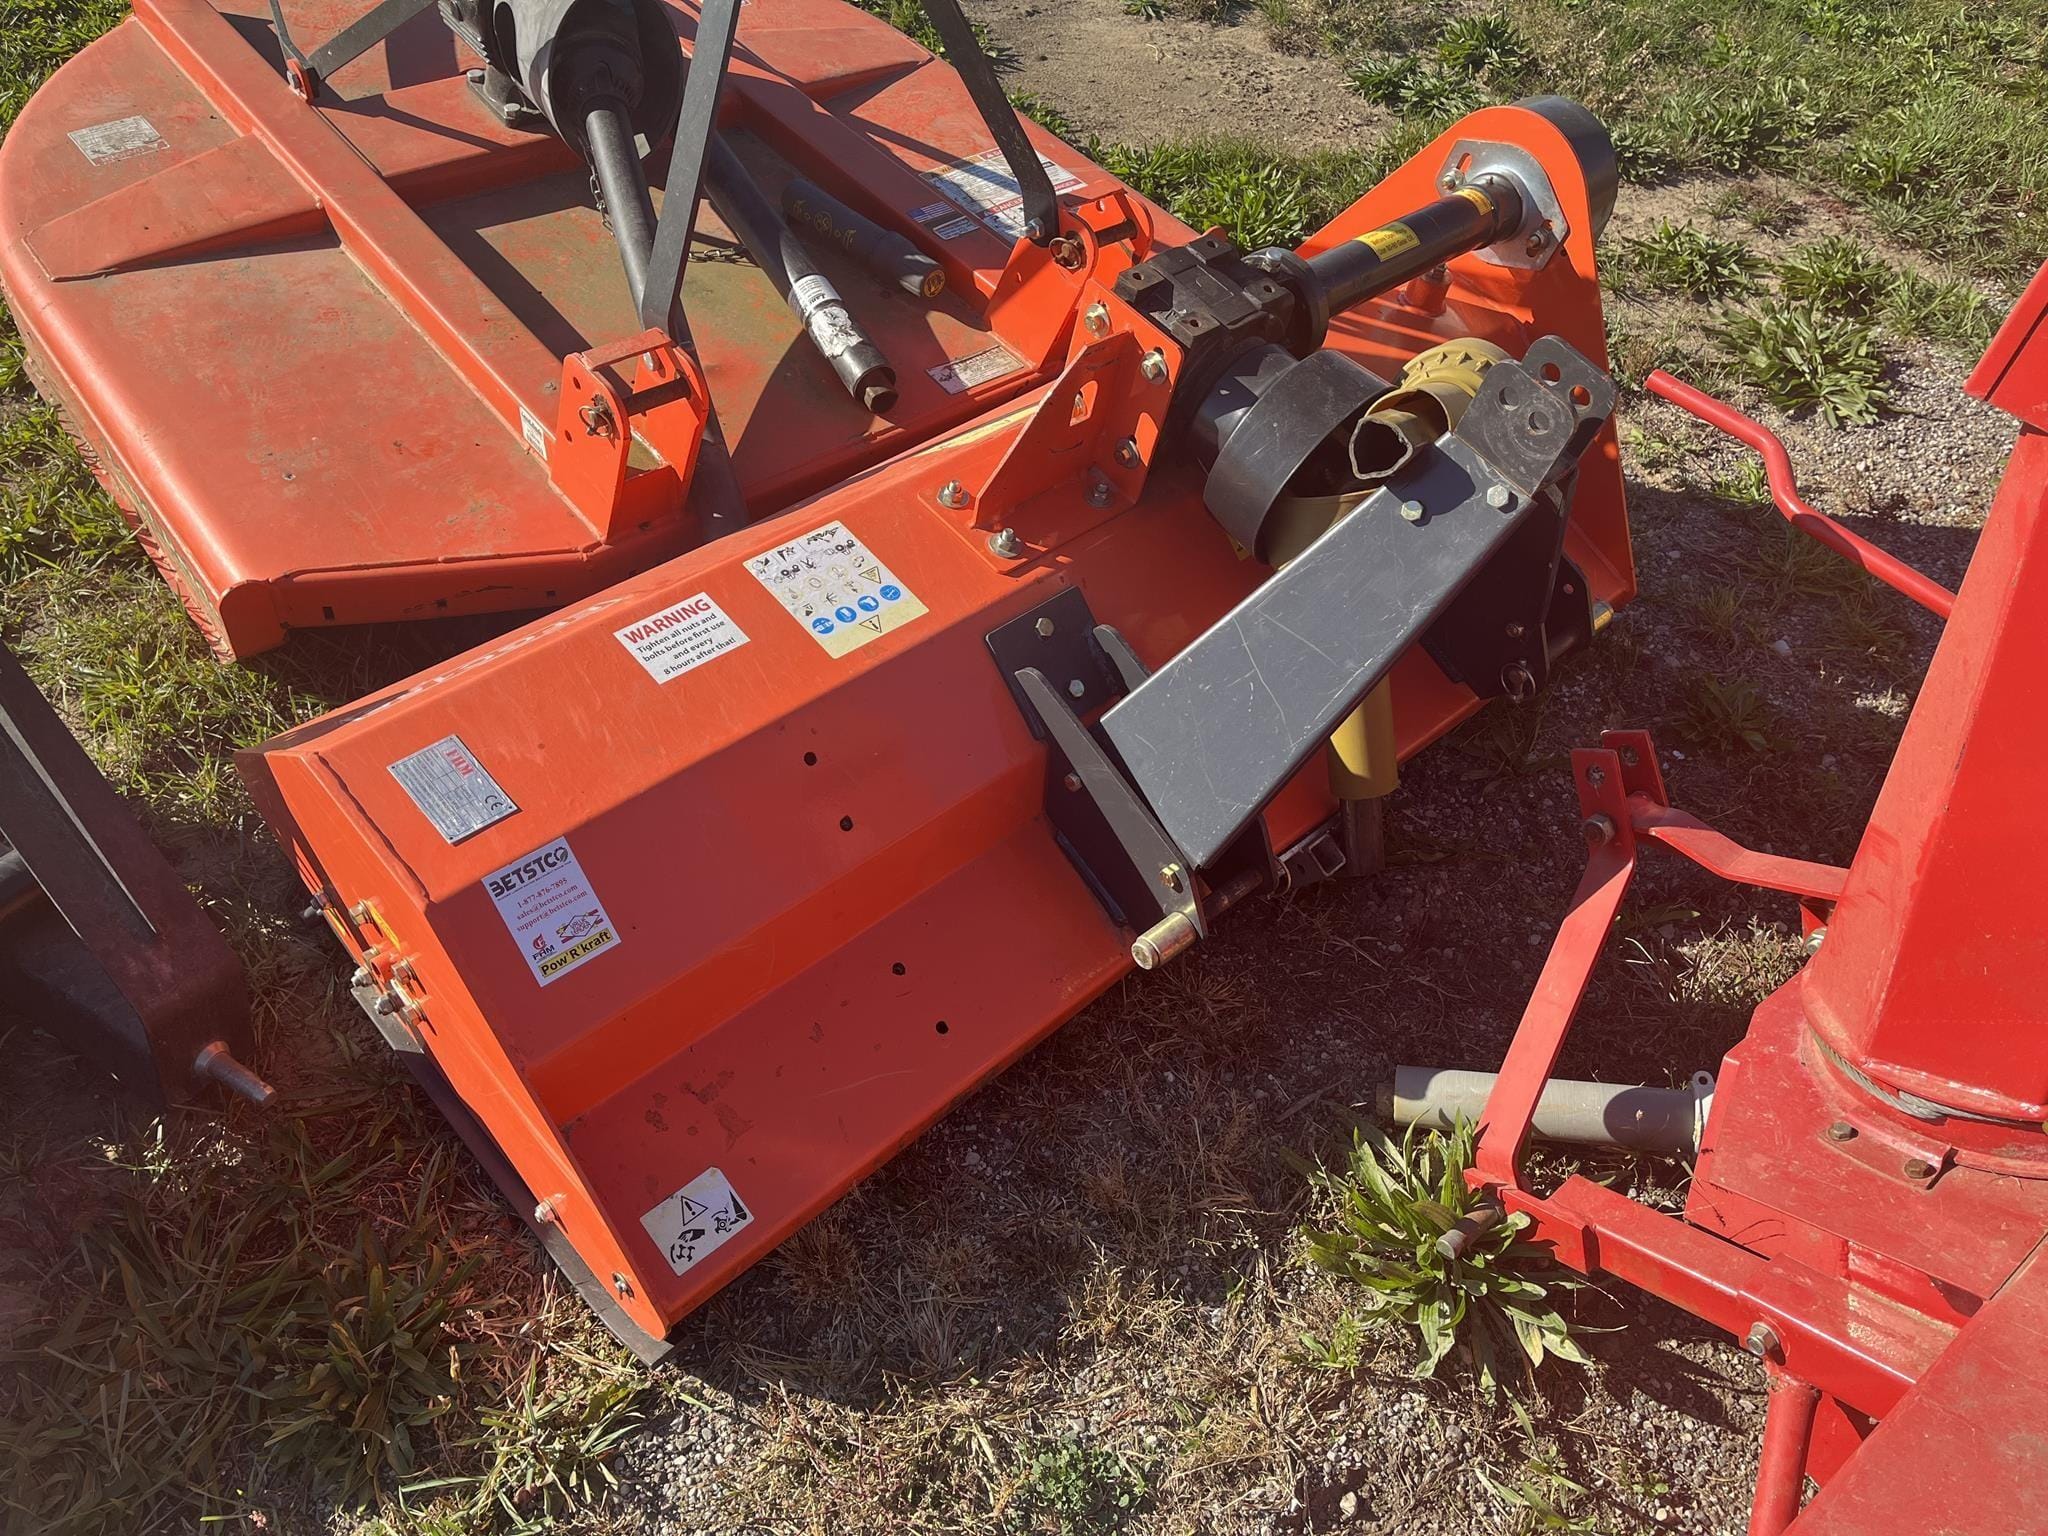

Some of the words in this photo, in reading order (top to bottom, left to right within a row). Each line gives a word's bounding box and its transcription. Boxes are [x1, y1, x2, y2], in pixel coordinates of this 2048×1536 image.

[623, 599, 711, 644] WARNING
[636, 635, 670, 653] Tighten
[671, 629, 681, 639] all
[682, 621, 701, 633] nuts
[701, 613, 717, 625] and
[643, 650, 665, 663] bolts
[666, 637, 693, 652] before
[693, 627, 710, 641] first
[711, 620, 725, 631] use
[670, 657, 695, 672] hours
[696, 647, 716, 661] after
[716, 636, 736, 651] that!
[673, 648, 690, 660] and
[690, 637, 713, 651] every
[489, 847, 569, 898] BETSTCO
[517, 884, 578, 920] sales@betstco.com
[517, 890, 588, 932] support@betstco.com
[541, 930, 611, 976] Pow'R'kraft
